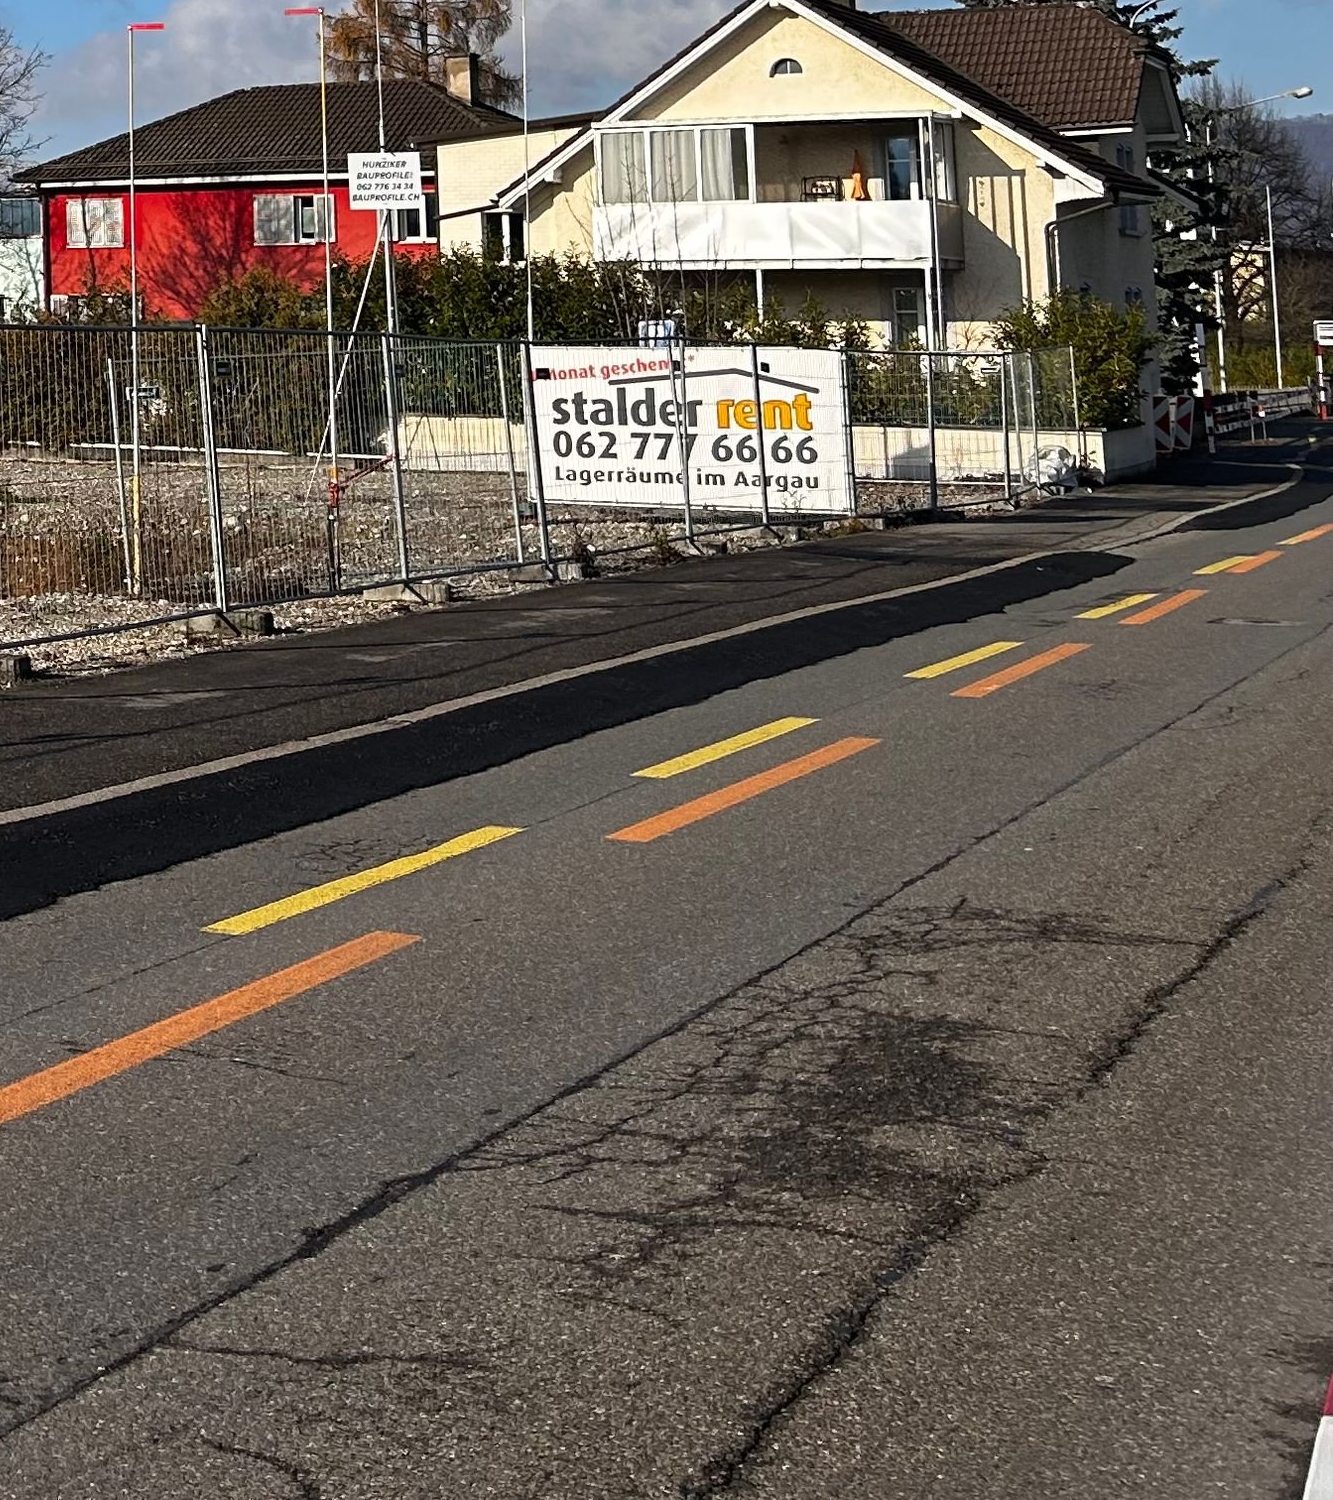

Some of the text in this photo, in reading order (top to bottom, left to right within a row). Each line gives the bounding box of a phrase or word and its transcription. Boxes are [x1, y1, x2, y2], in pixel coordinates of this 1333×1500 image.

[362, 160, 407, 169] HUNZIKER
[352, 193, 420, 202] BAUPROFILE.CH
[551, 387, 814, 431] stalder rent
[552, 430, 618, 459] 062
[711, 434, 757, 463] 66
[771, 435, 818, 465] 66
[696, 468, 726, 486] im
[733, 471, 819, 492] Aargau
